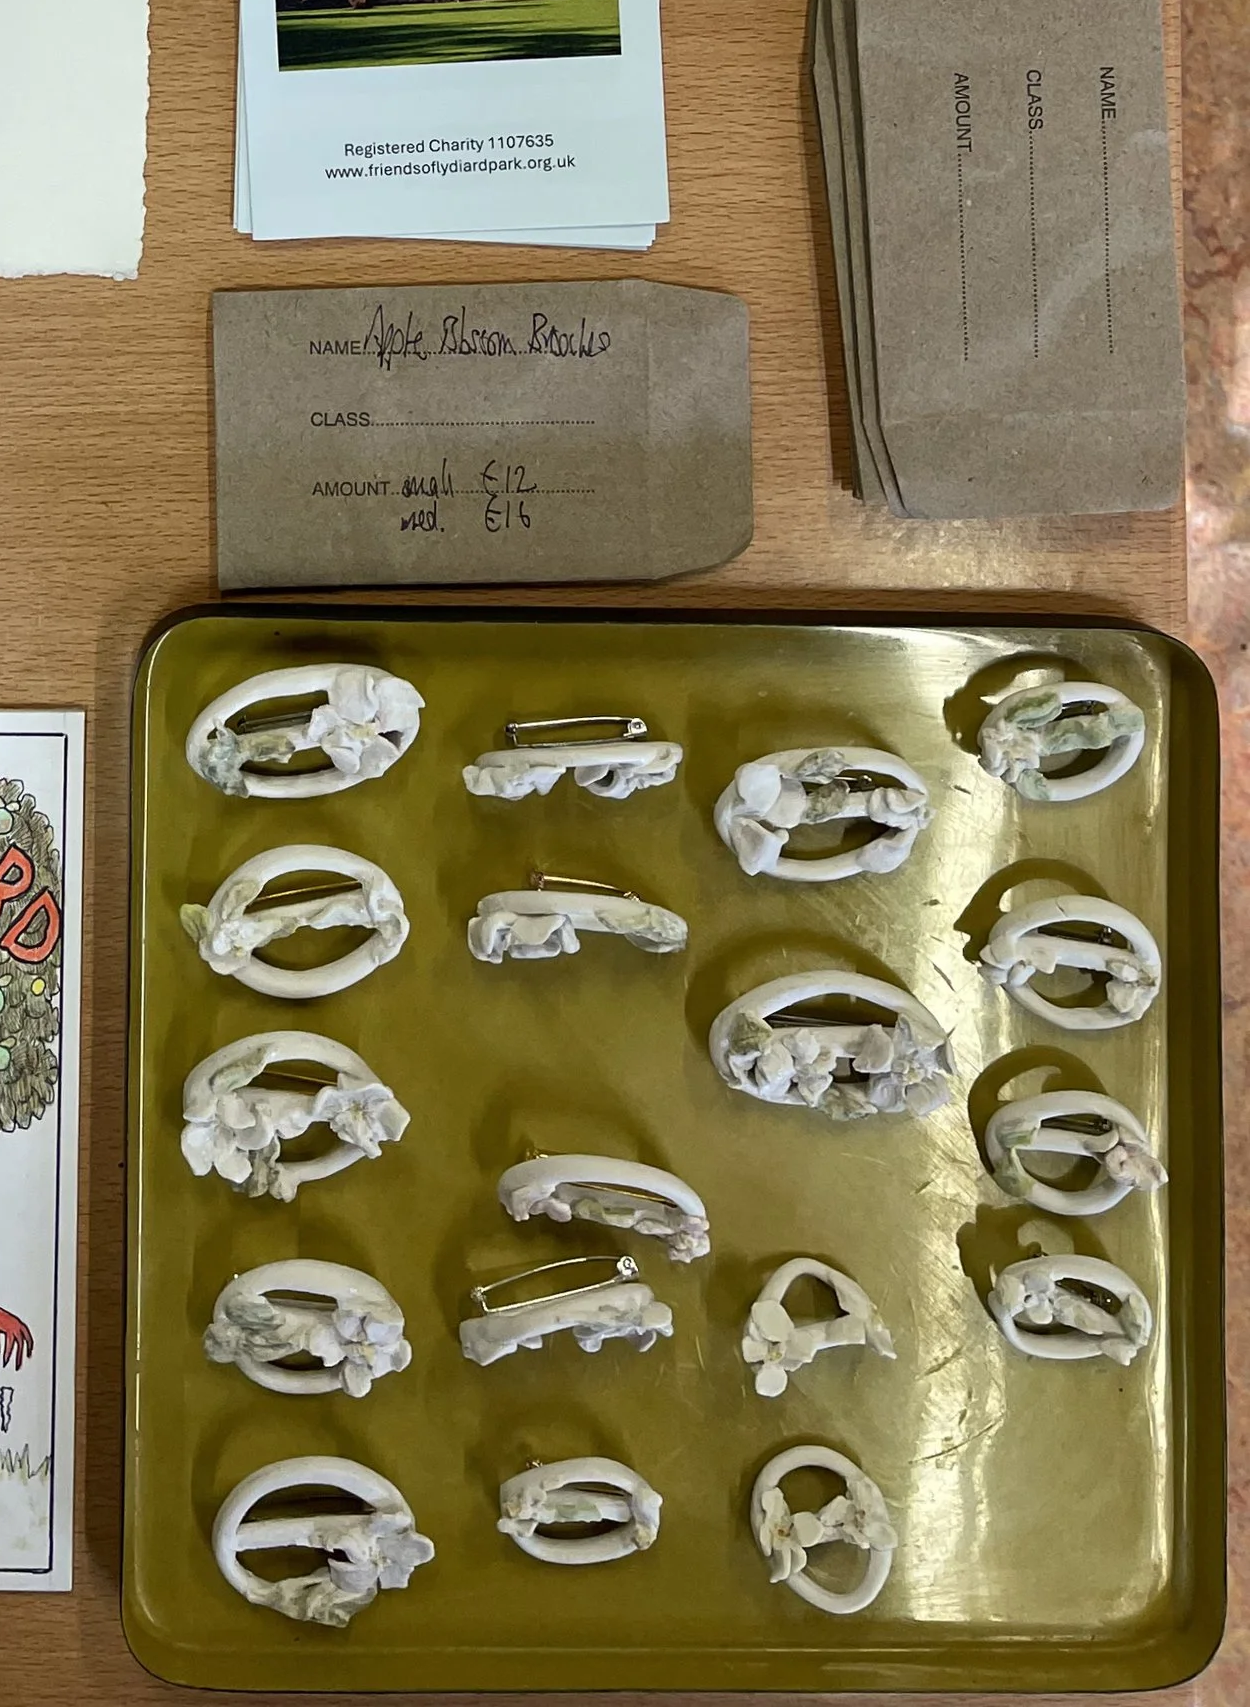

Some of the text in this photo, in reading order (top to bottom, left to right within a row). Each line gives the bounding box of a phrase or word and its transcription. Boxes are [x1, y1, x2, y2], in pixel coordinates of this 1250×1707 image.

[1025, 69, 1044, 131] CLASS
[1099, 67, 1116, 120] NAME
[953, 73, 973, 152] AMOUNT
[344, 133, 554, 157] Registered Charity 1107635
[324, 152, 576, 180] www.friendsoflydiardpark.org.uk
[310, 340, 361, 355] NAME
[310, 413, 371, 427] CLASS
[312, 482, 391, 496] AMOUNT
